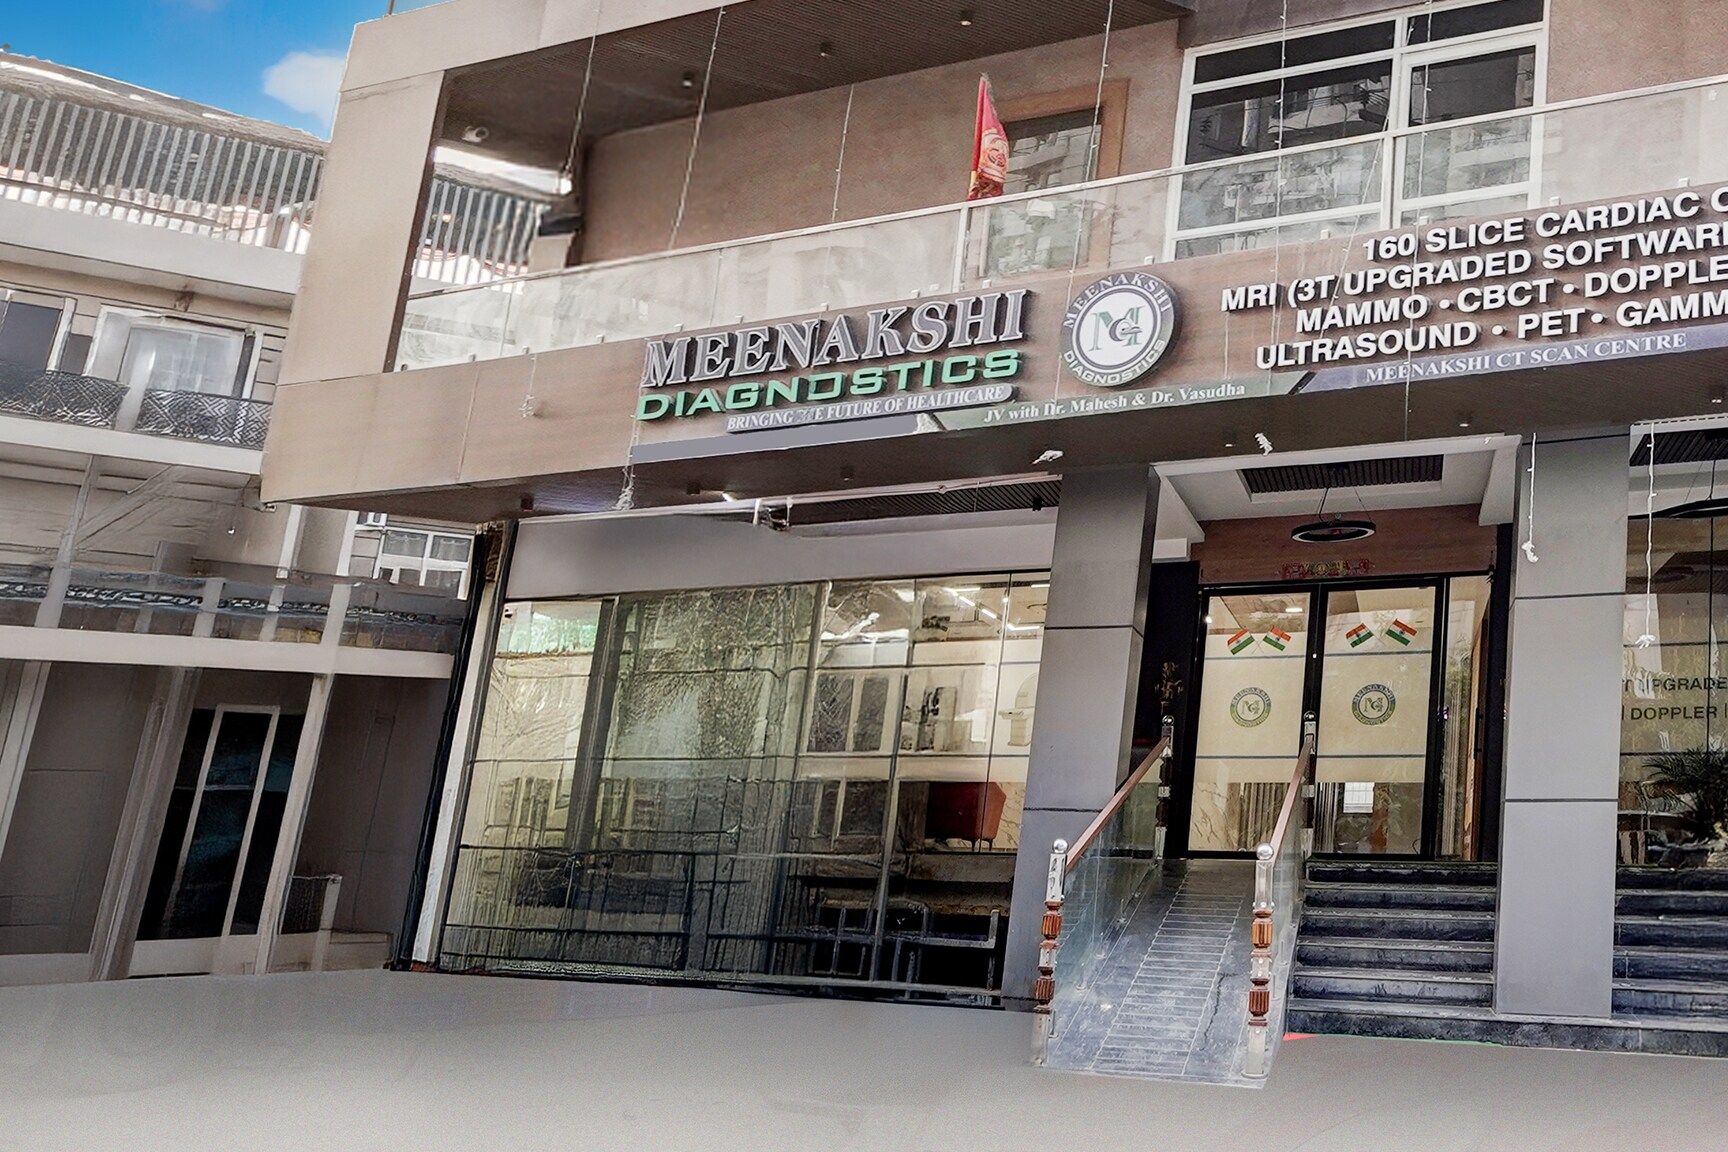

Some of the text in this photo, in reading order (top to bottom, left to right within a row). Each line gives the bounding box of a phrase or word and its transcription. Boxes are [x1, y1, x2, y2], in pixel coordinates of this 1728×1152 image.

[1363, 233, 1416, 261] 160
[1425, 218, 1525, 252] SLICE
[1536, 191, 1700, 237] CARDIAC
[1063, 273, 1172, 328] MEENAKSHI
[1221, 283, 1277, 311] MRI
[1288, 274, 1336, 307] (3T
[1343, 249, 1532, 295] UPGRADED
[1296, 294, 1429, 333] MAMMO
[1457, 278, 1554, 312] CBCT
[641, 289, 1027, 388] MEENAKSHI
[1063, 339, 1166, 384] DIAGNOSTICS
[1256, 321, 1478, 370] ULTRASOUND
[1518, 308, 1586, 339] PET
[1365, 333, 1687, 382] MEENAKSHI CT SCAN CENTRE
[636, 349, 1020, 421] DIAGNOSTICS
[727, 410, 794, 431] BRINGING
[826, 402, 883, 419] FUTURE
[884, 397, 904, 412] OF
[907, 385, 1004, 410] HEALTHCARE
[984, 383, 1245, 423] JV with Dr. Mahesh & Dr. Vasudha
[1630, 706, 1718, 721] DOPPLER
